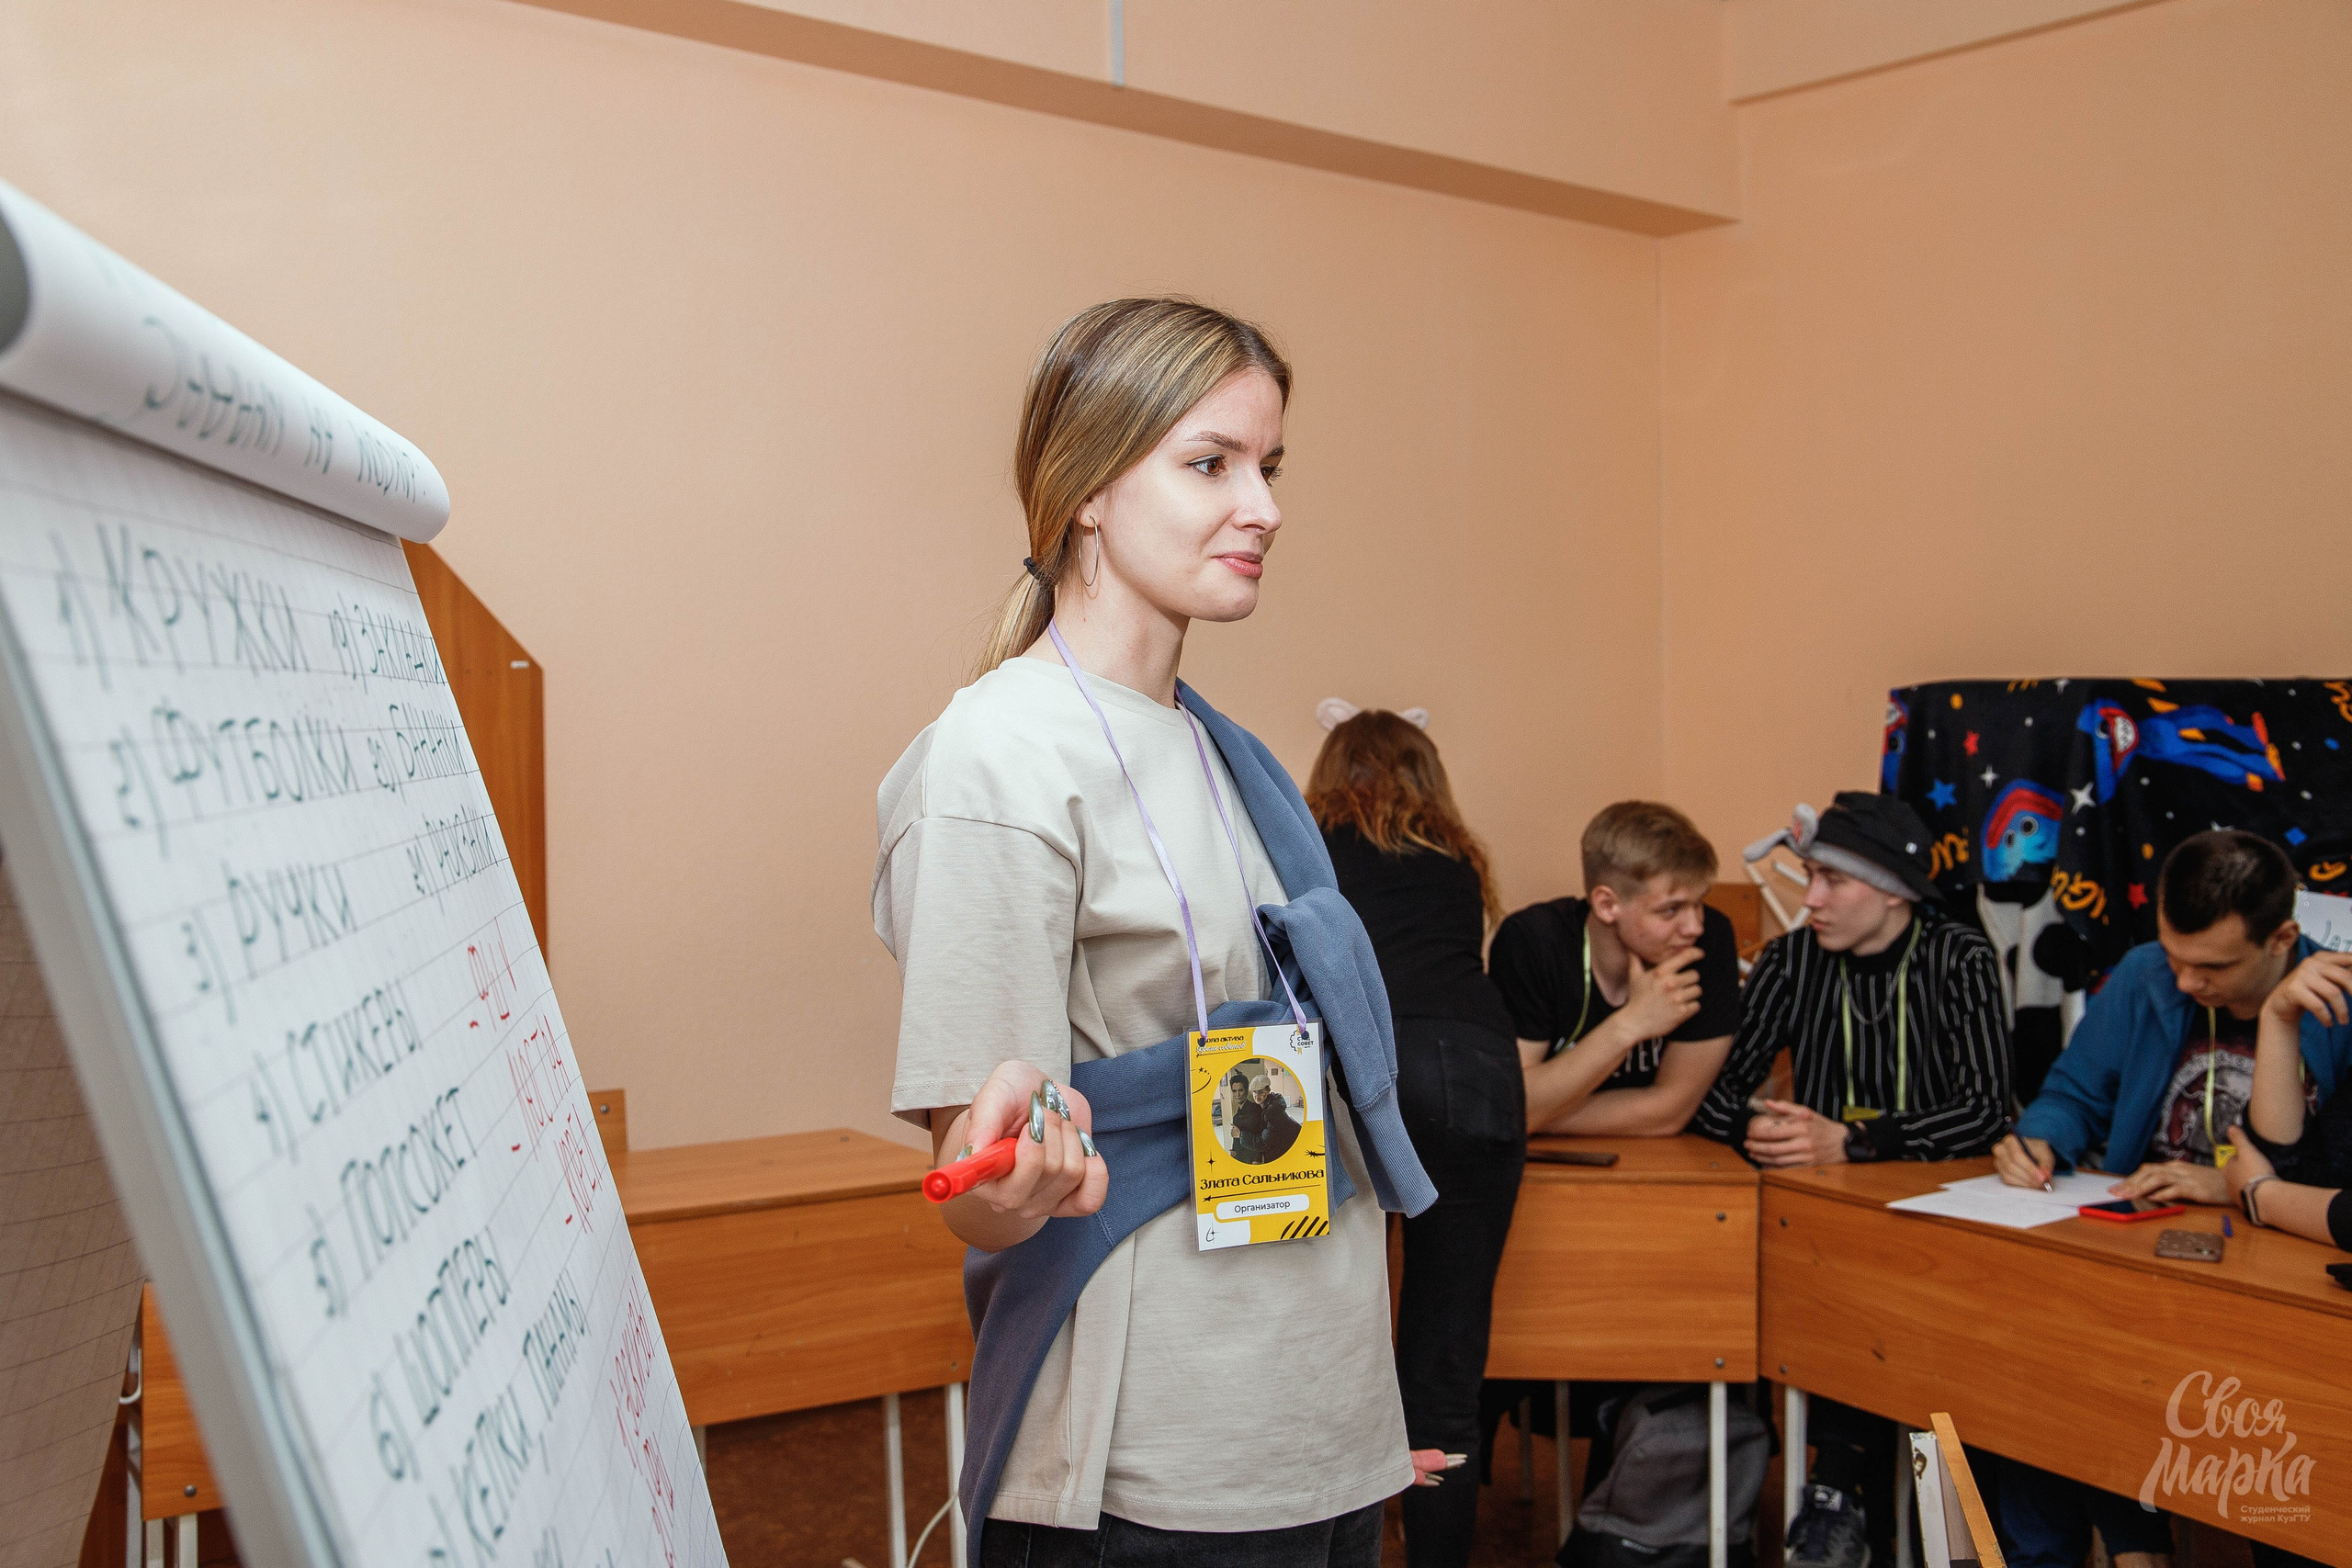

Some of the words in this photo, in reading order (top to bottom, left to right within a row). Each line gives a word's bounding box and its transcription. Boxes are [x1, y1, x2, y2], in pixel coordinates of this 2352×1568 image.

[96, 524, 311, 678] КРУЖКИ
[153, 695, 360, 818] ФУТБОЛКИ
[221, 858, 358, 980] РУЧКИ
[286, 977, 424, 1125] СТИКЕРЫ
[341, 1088, 478, 1282] ПОПСОКЕТ
[1200, 1177, 1240, 1190] Злата
[1242, 1168, 1324, 1185] Сальникова
[1234, 1200, 1291, 1213] Организатор
